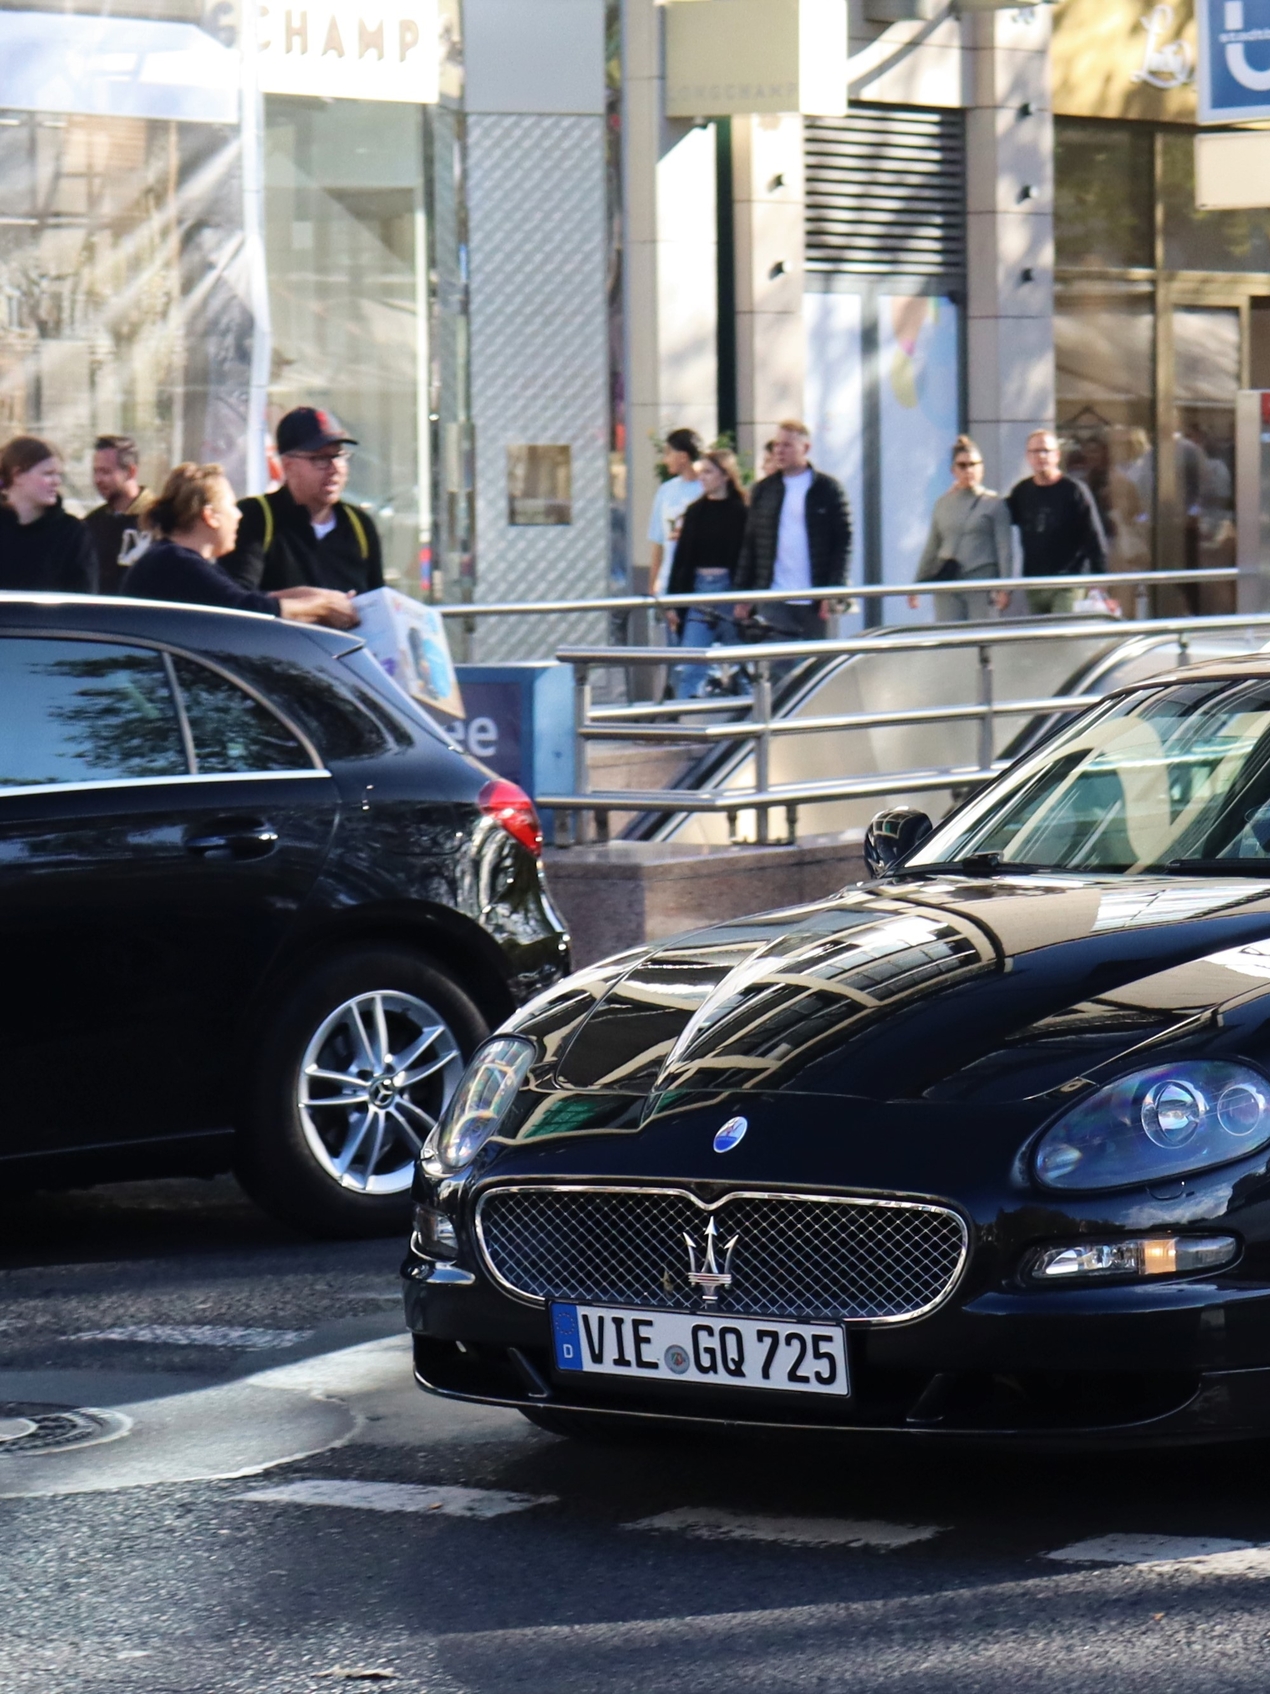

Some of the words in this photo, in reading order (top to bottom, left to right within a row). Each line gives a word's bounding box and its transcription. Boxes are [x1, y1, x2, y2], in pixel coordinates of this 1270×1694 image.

[563, 1344, 573, 1358] D
[581, 1313, 659, 1369] VIE
[691, 1323, 746, 1378] GQ
[757, 1329, 837, 1386] 725
